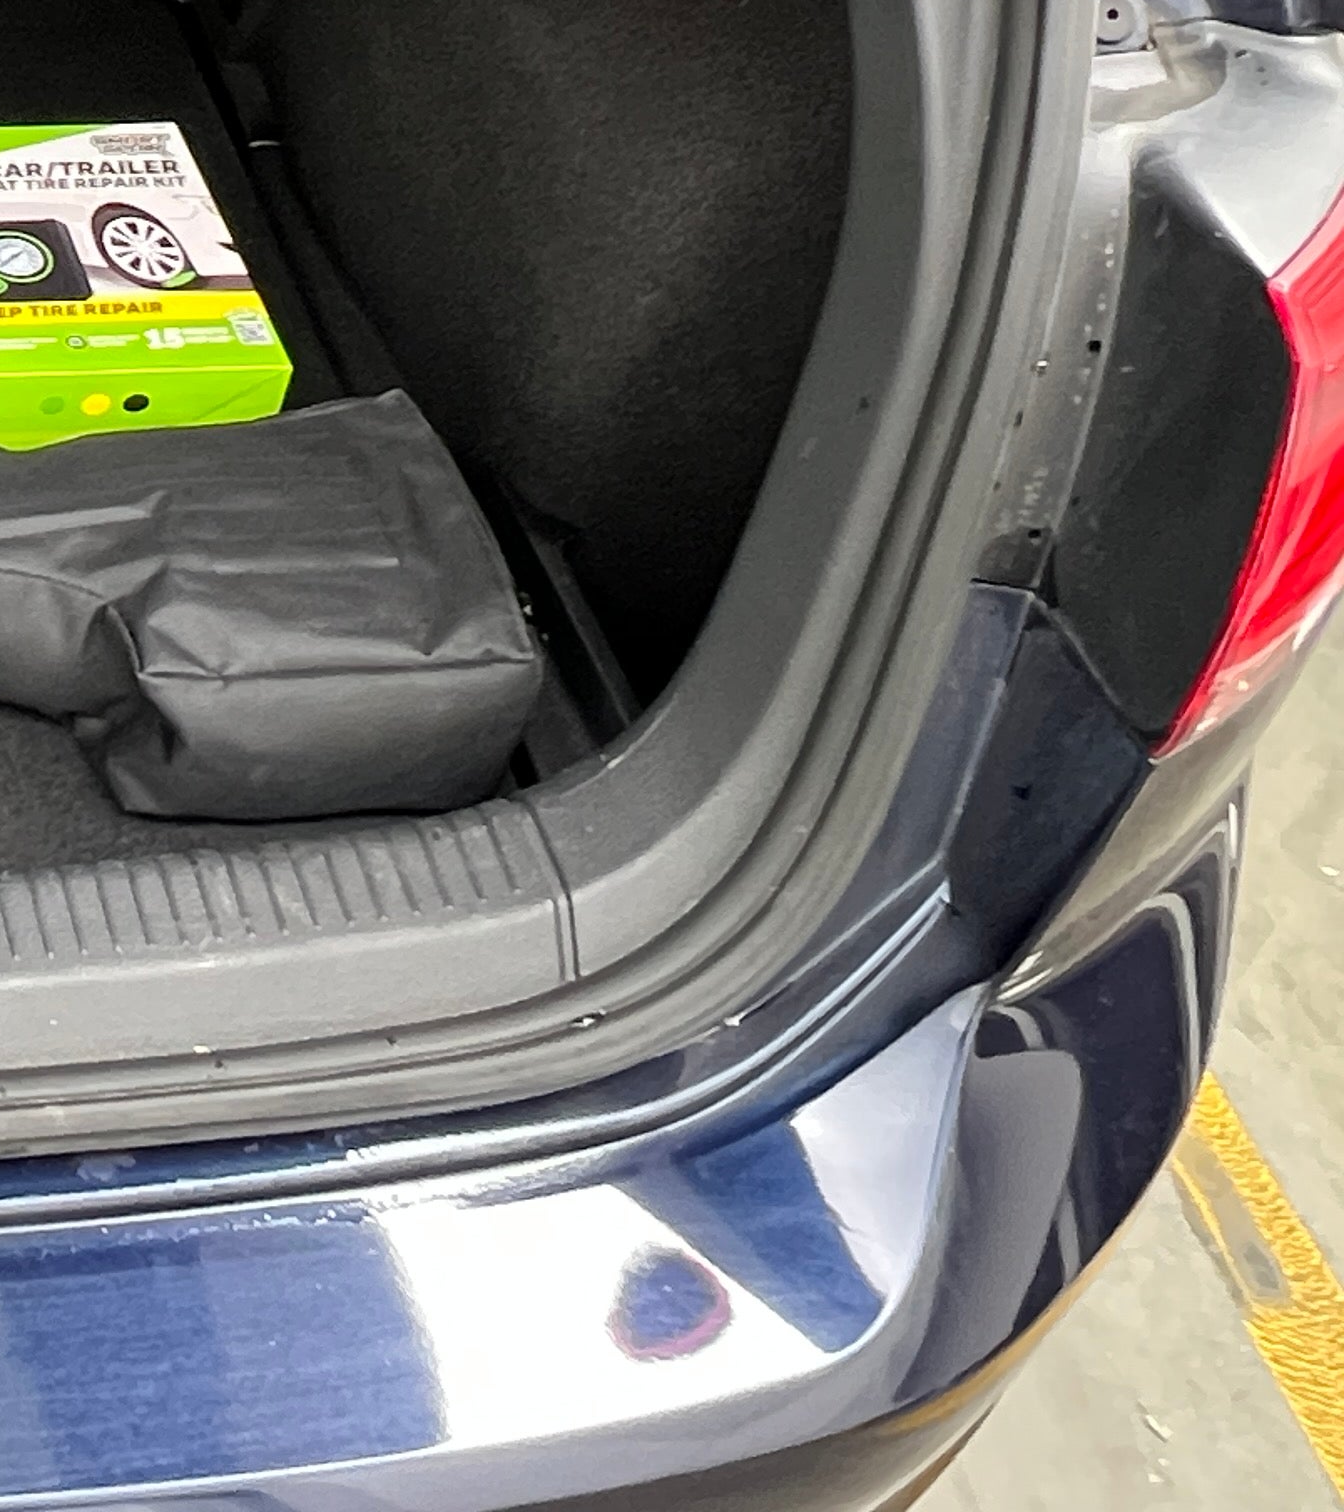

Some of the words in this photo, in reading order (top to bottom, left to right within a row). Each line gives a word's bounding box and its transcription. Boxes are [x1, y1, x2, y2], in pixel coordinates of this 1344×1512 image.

[24, 178, 71, 191] TIRE
[75, 176, 150, 189] REPAIR
[153, 175, 187, 188] KIT
[29, 304, 79, 318] TIRE
[83, 301, 164, 316] REPAIR
